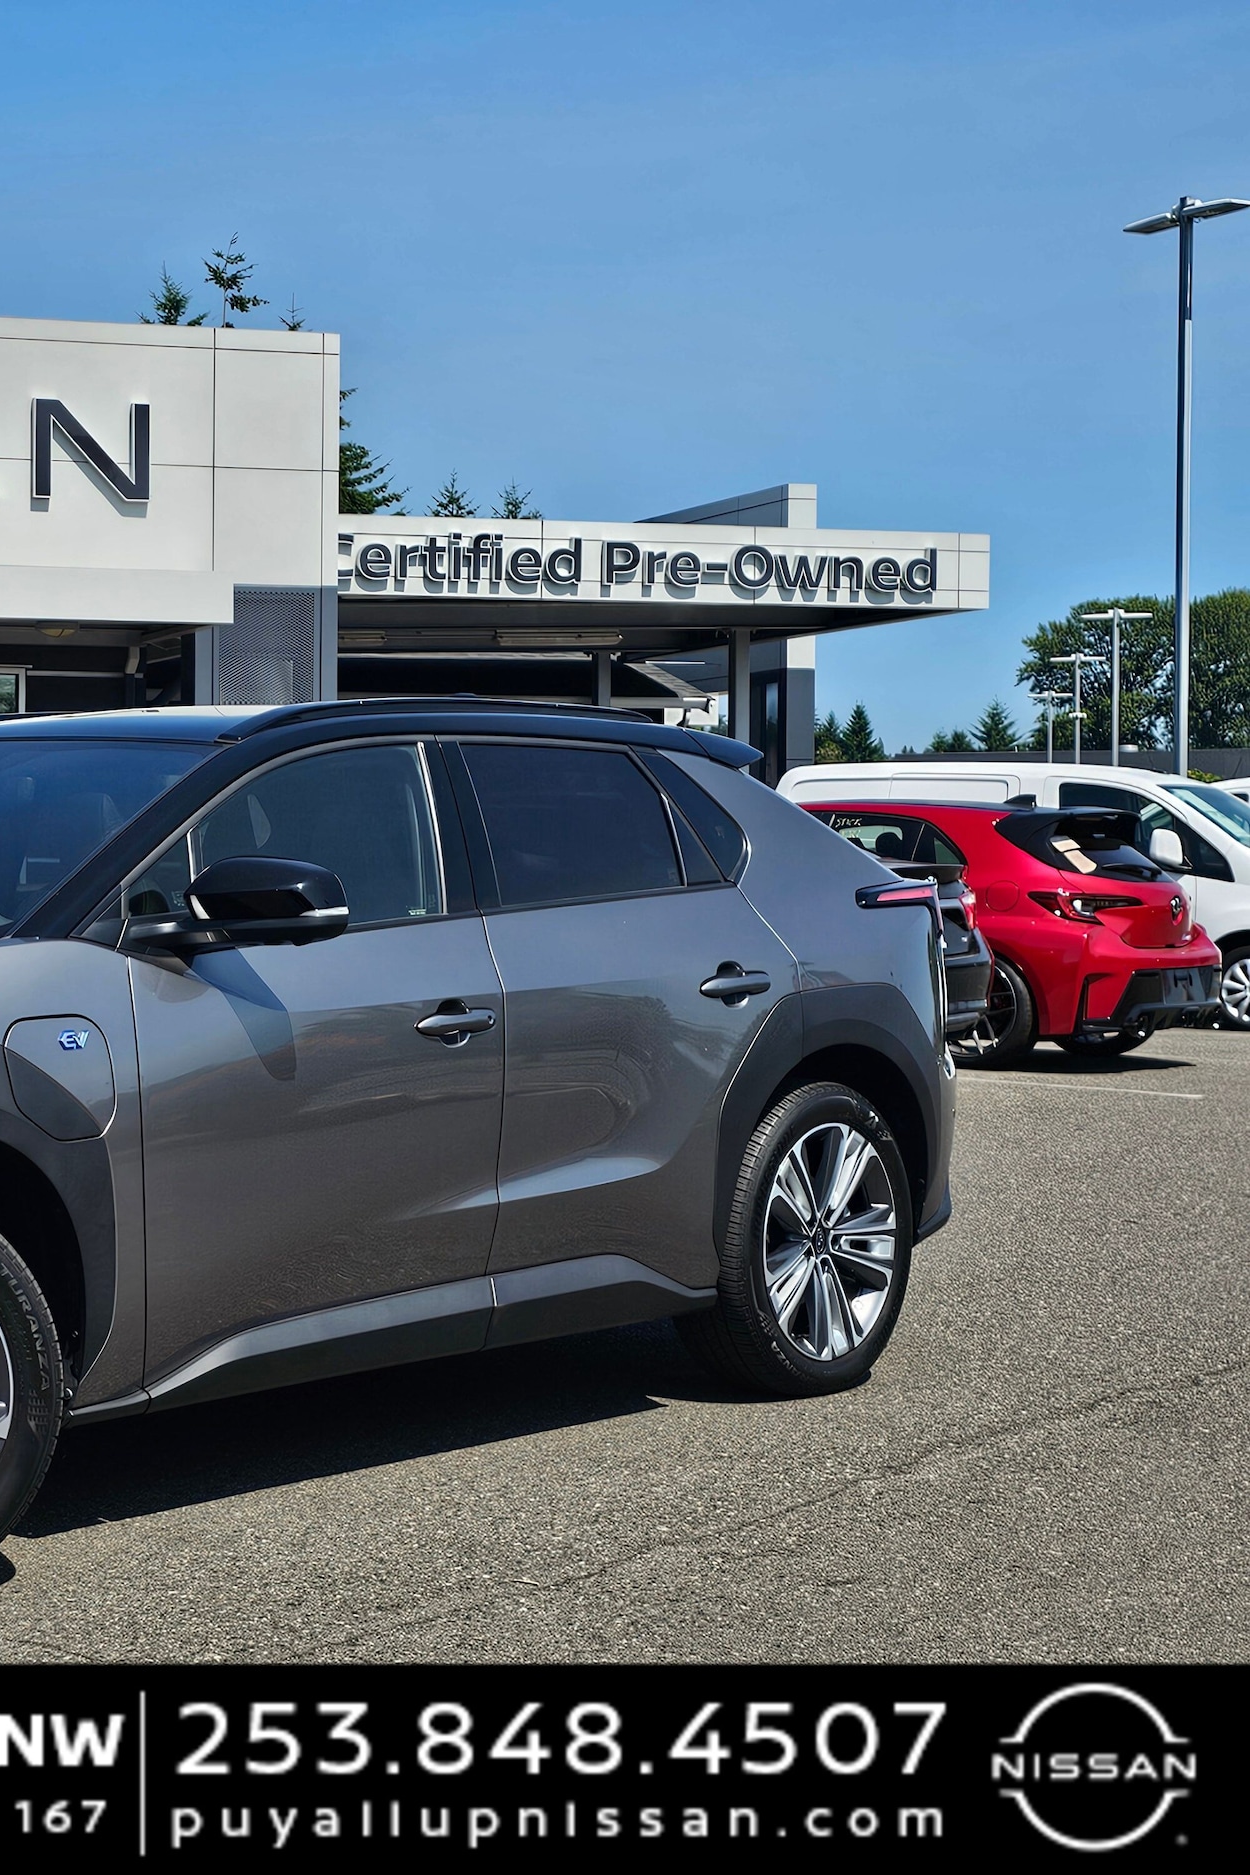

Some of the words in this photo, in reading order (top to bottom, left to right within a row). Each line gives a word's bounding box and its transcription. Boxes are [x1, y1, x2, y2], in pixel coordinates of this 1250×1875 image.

[605, 541, 939, 593] Pre-Owned
[57, 1029, 90, 1051] EV
[0, 1262, 51, 1391] TURANZA
